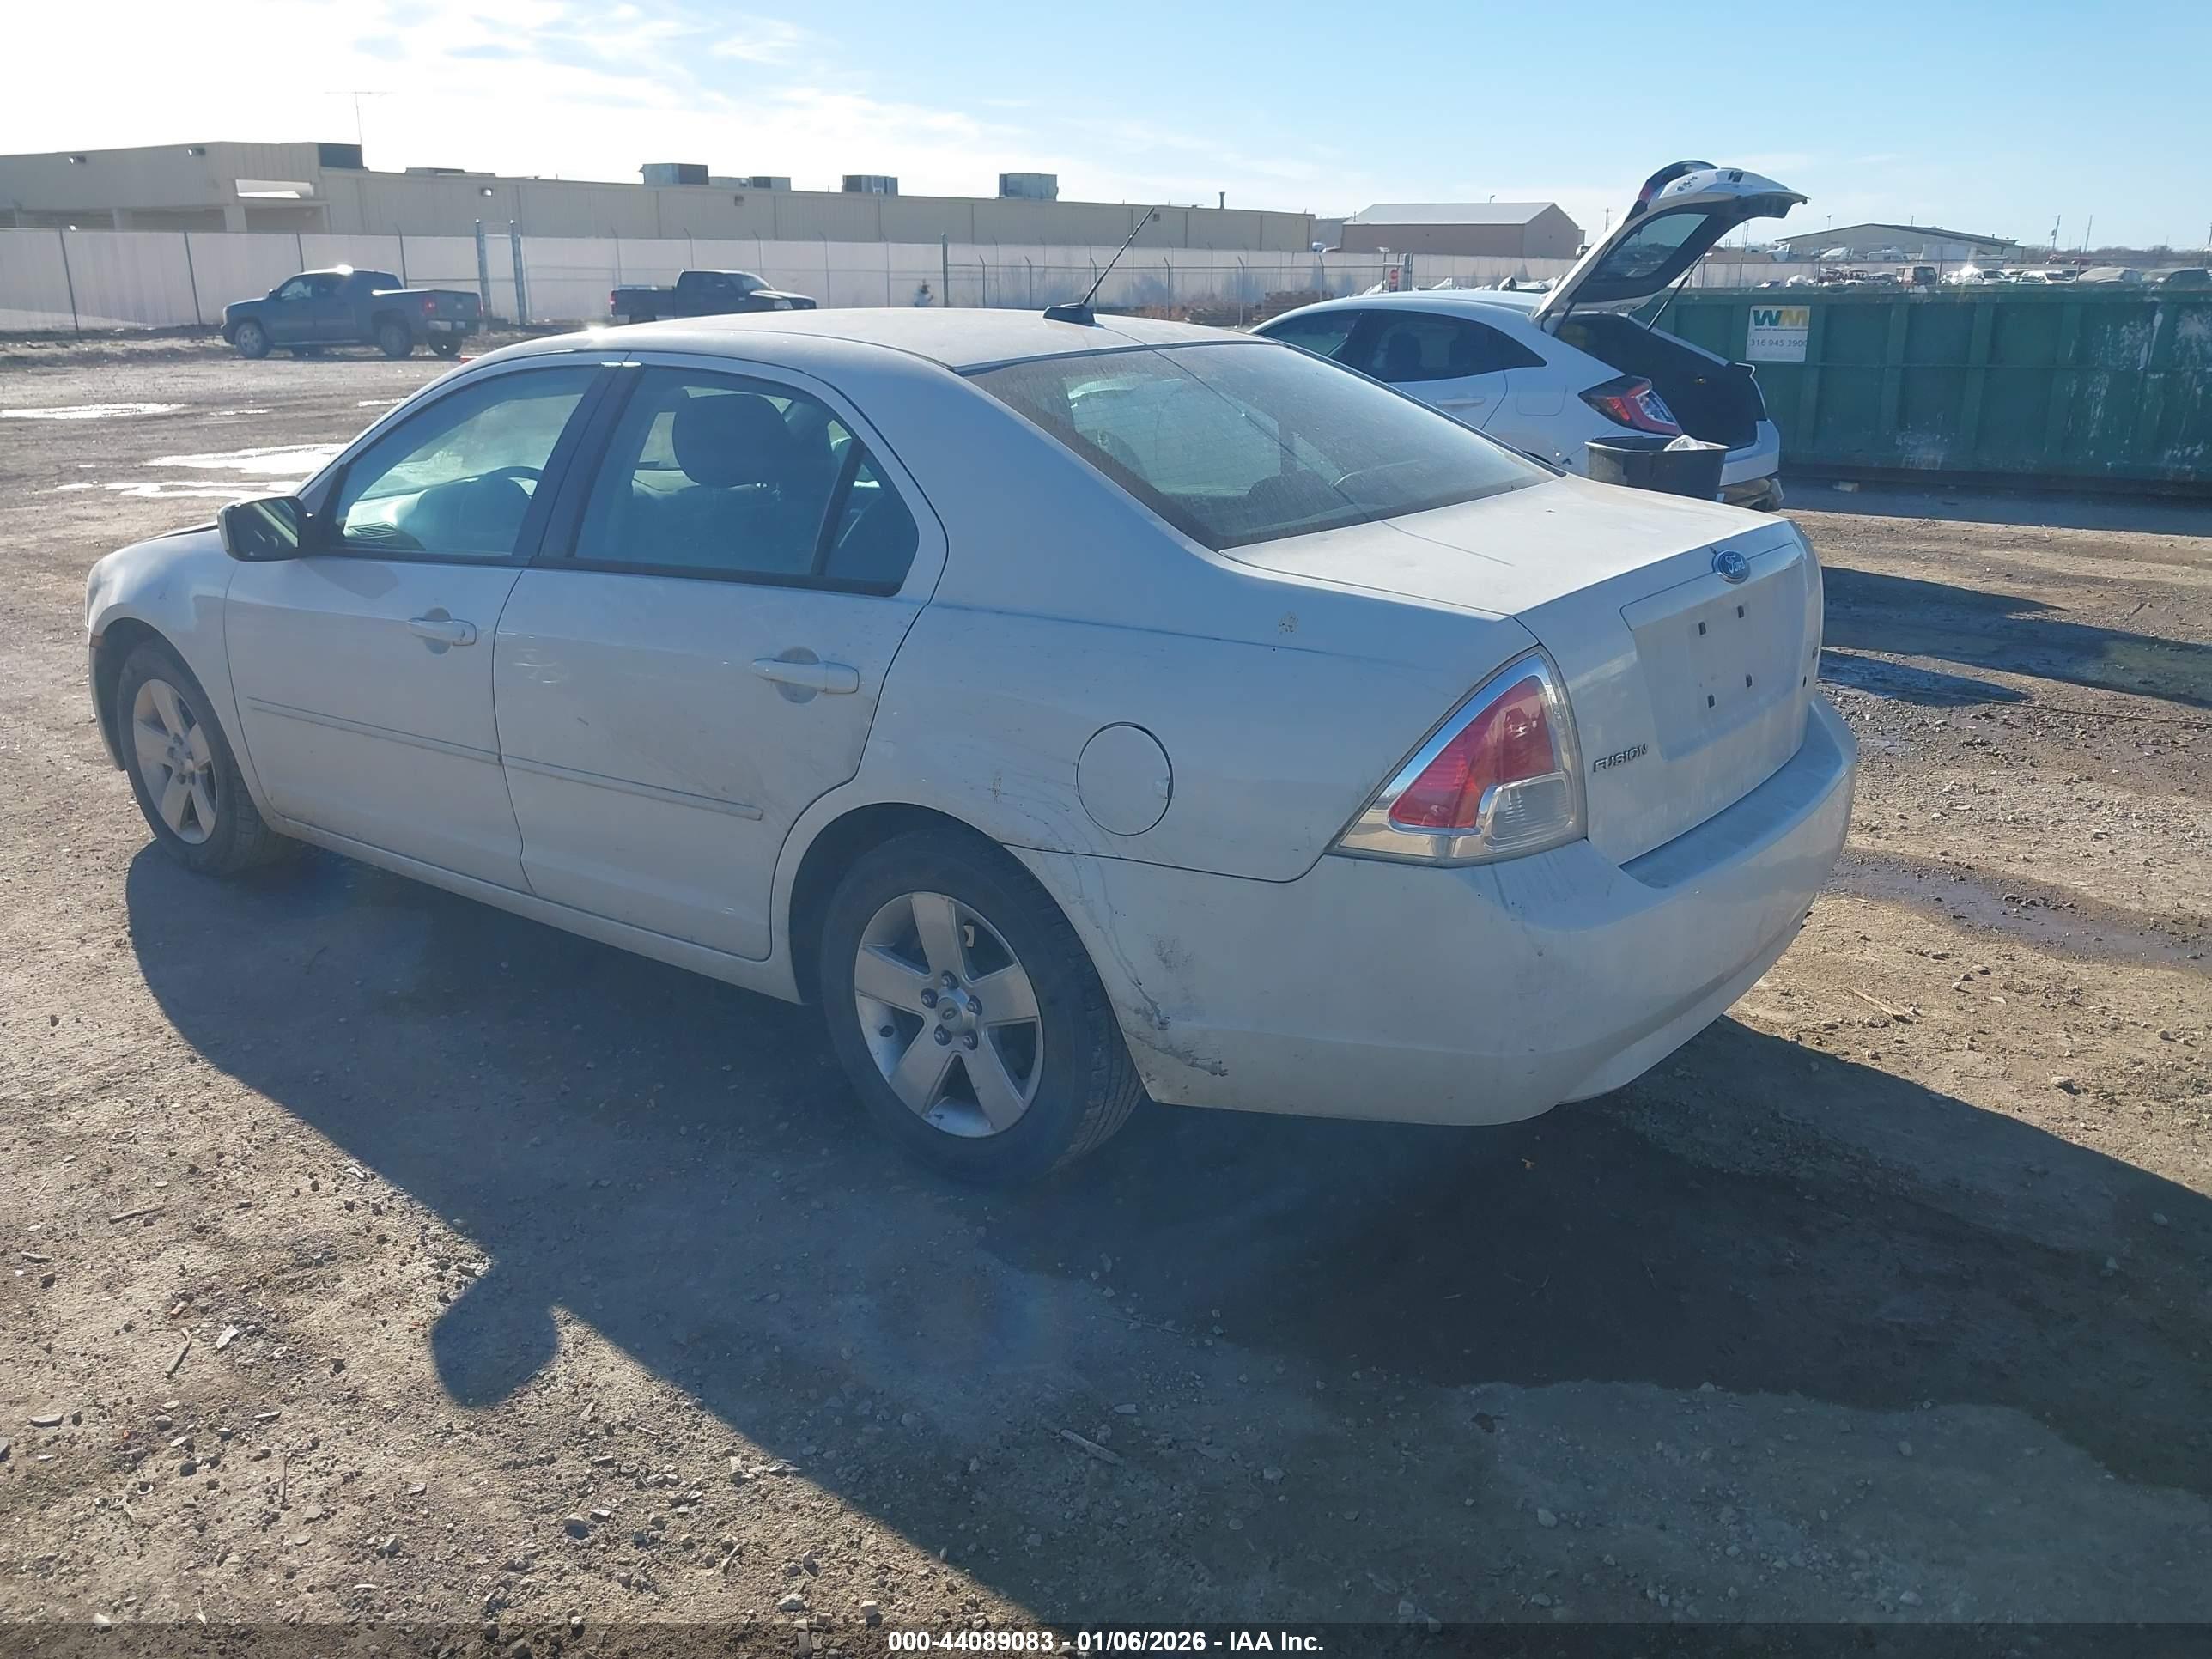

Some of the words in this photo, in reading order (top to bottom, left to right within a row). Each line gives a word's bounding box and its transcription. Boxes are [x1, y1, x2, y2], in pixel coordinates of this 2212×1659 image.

[1753, 309, 1808, 327] WM
[1751, 338, 1766, 347] 316
[1768, 338, 1784, 347] 945
[1725, 555, 1746, 574] Ford
[1593, 743, 1649, 773] FUSION
